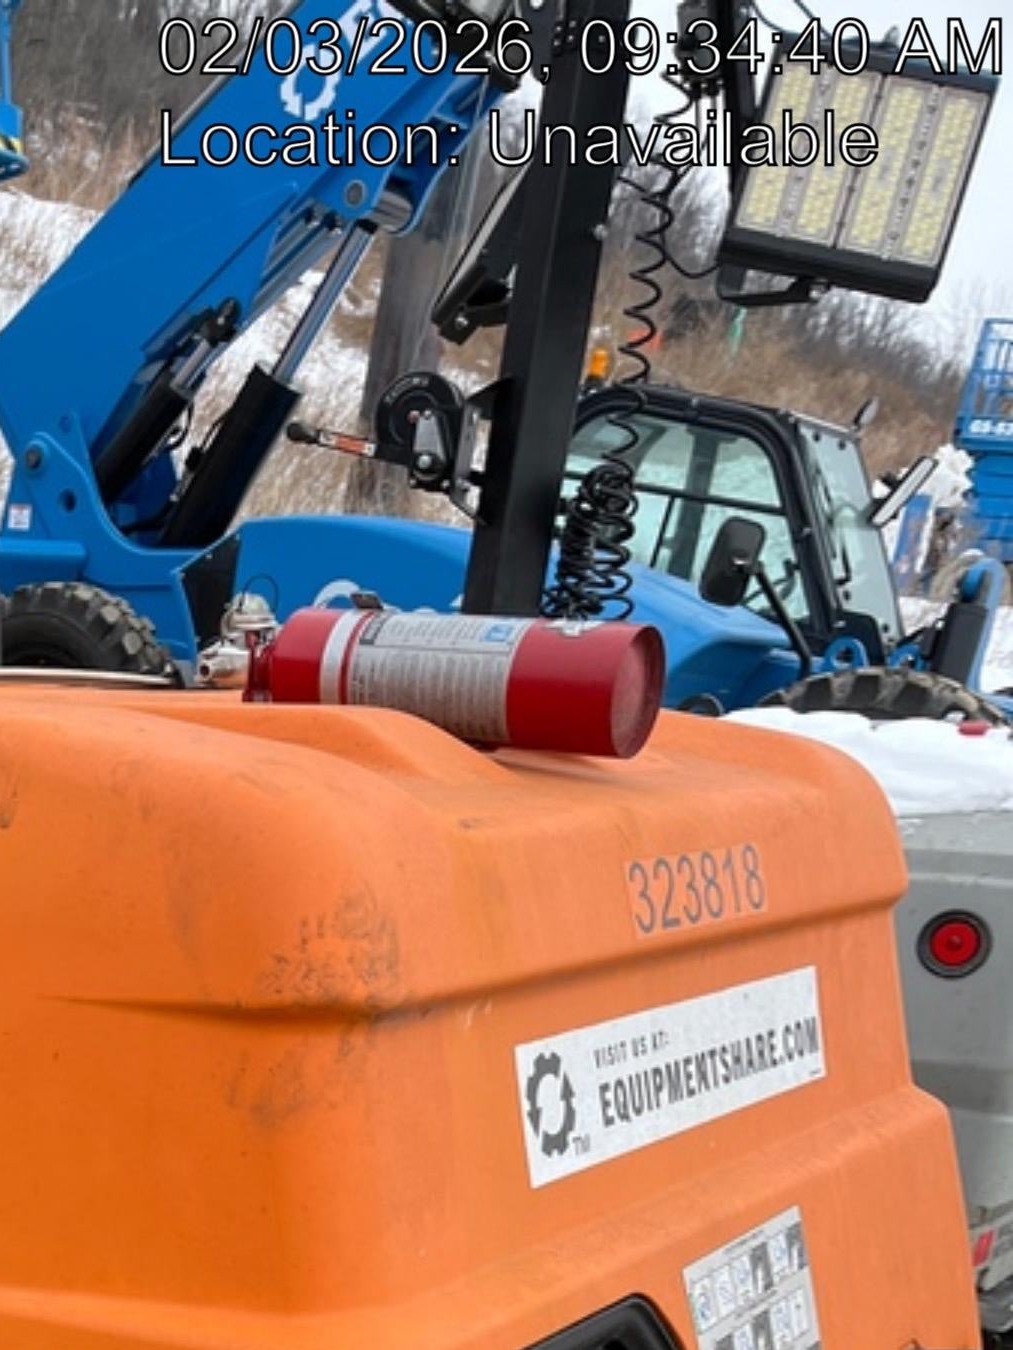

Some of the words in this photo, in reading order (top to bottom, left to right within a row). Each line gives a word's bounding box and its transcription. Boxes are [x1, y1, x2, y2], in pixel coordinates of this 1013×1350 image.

[628, 845, 765, 934] 323818
[593, 1040, 627, 1069] VISIT
[631, 1035, 647, 1058] US
[599, 1015, 819, 1128] EQUIPMENTSHARE.COM
